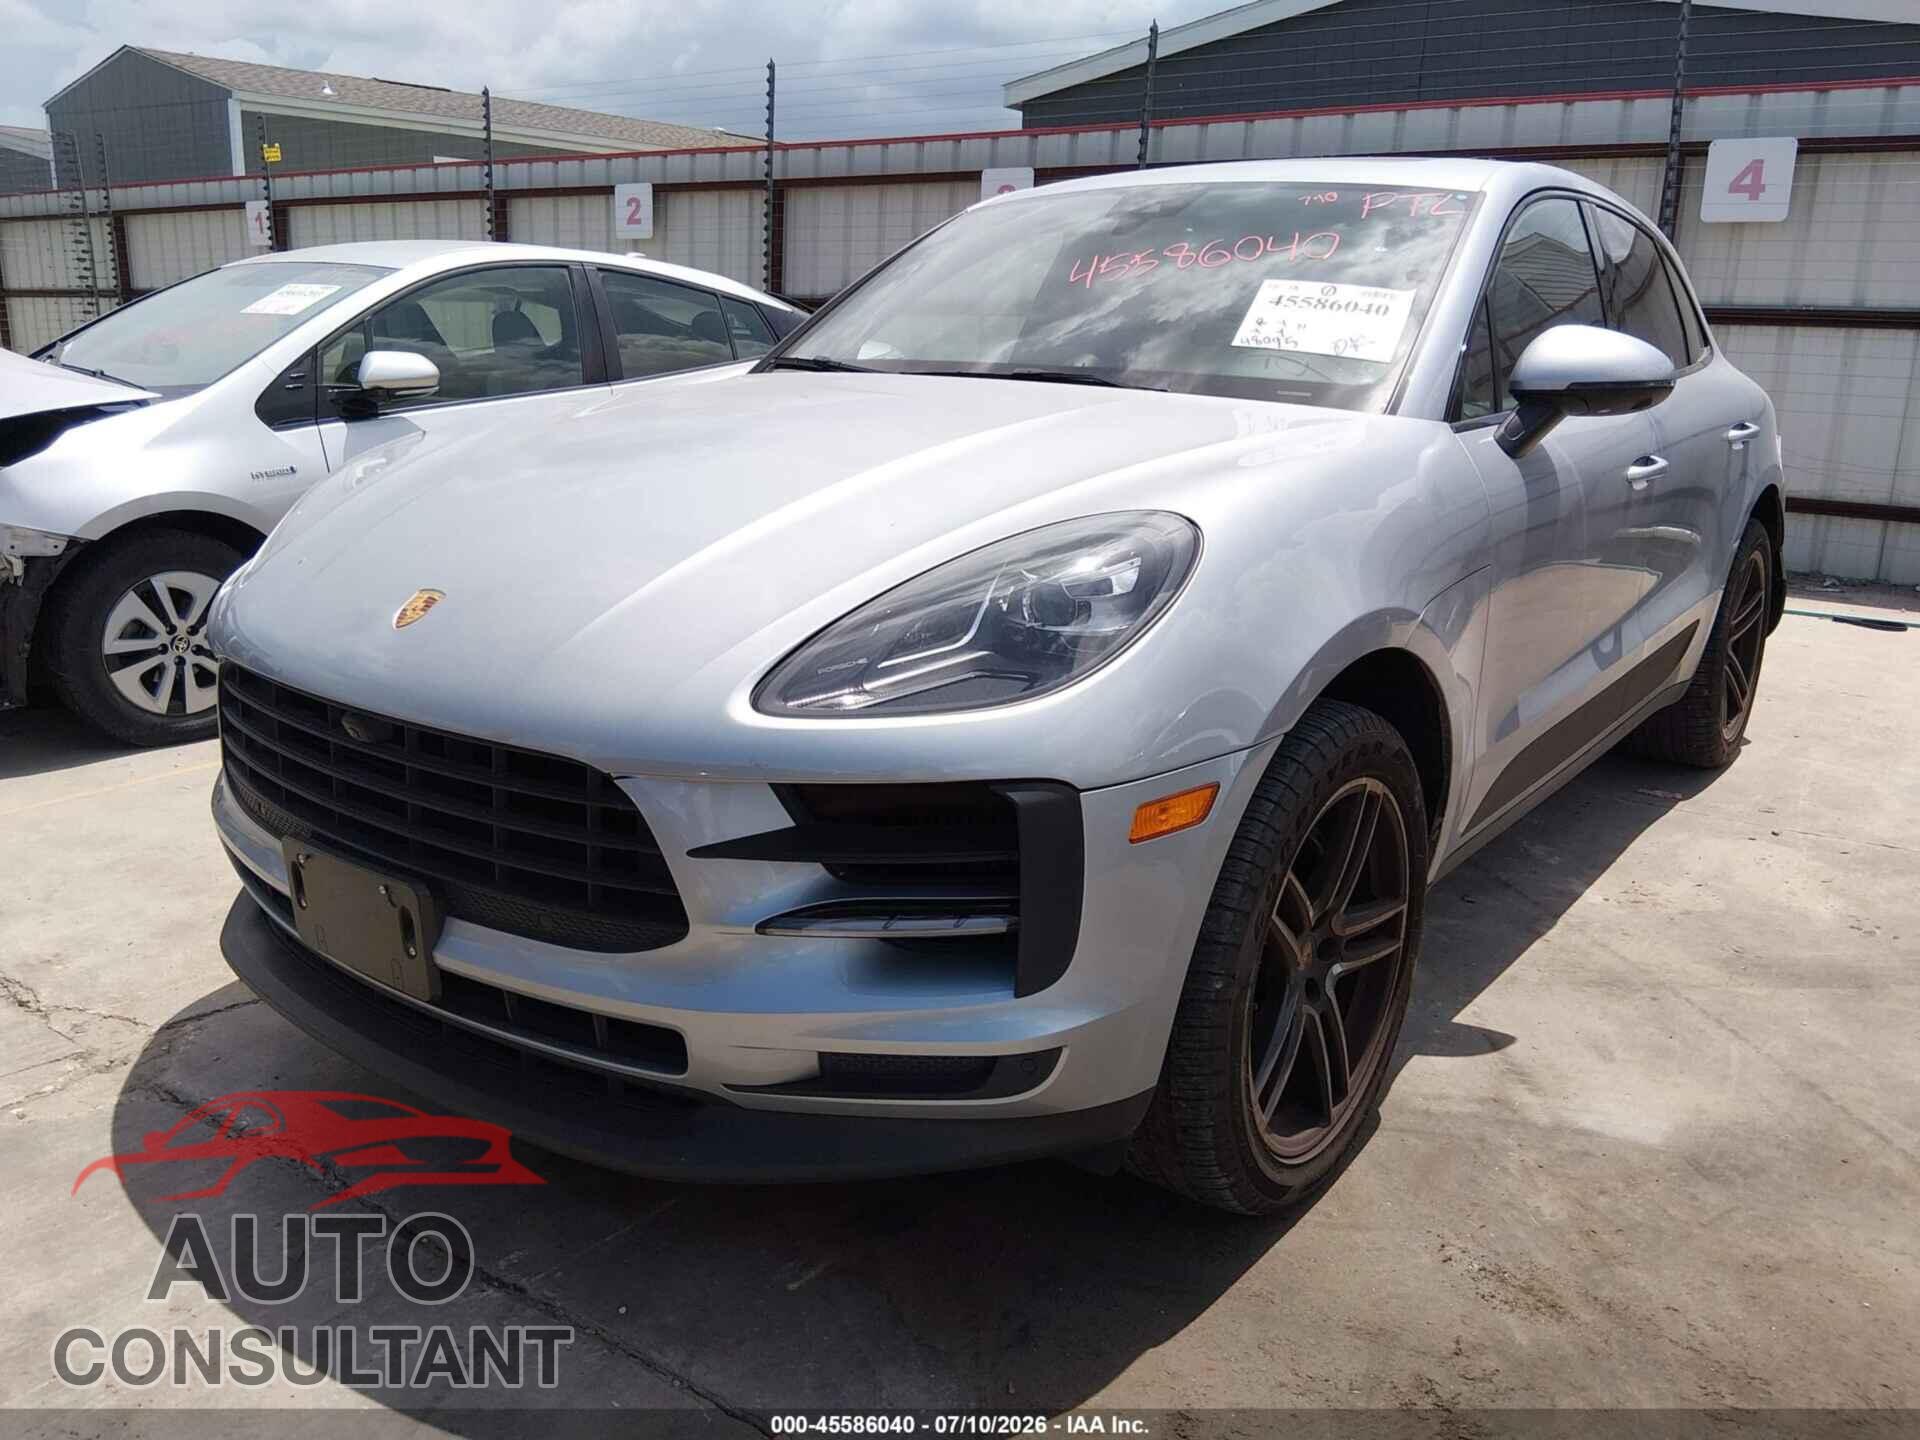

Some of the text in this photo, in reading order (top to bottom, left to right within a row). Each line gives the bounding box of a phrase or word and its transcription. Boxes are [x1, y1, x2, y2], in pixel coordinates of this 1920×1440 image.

[1728, 159, 1765, 201] 4
[255, 212, 264, 234] 1
[626, 196, 641, 225] 2
[1069, 232, 1340, 288] 45586040
[1268, 295, 1390, 317] 45586040
